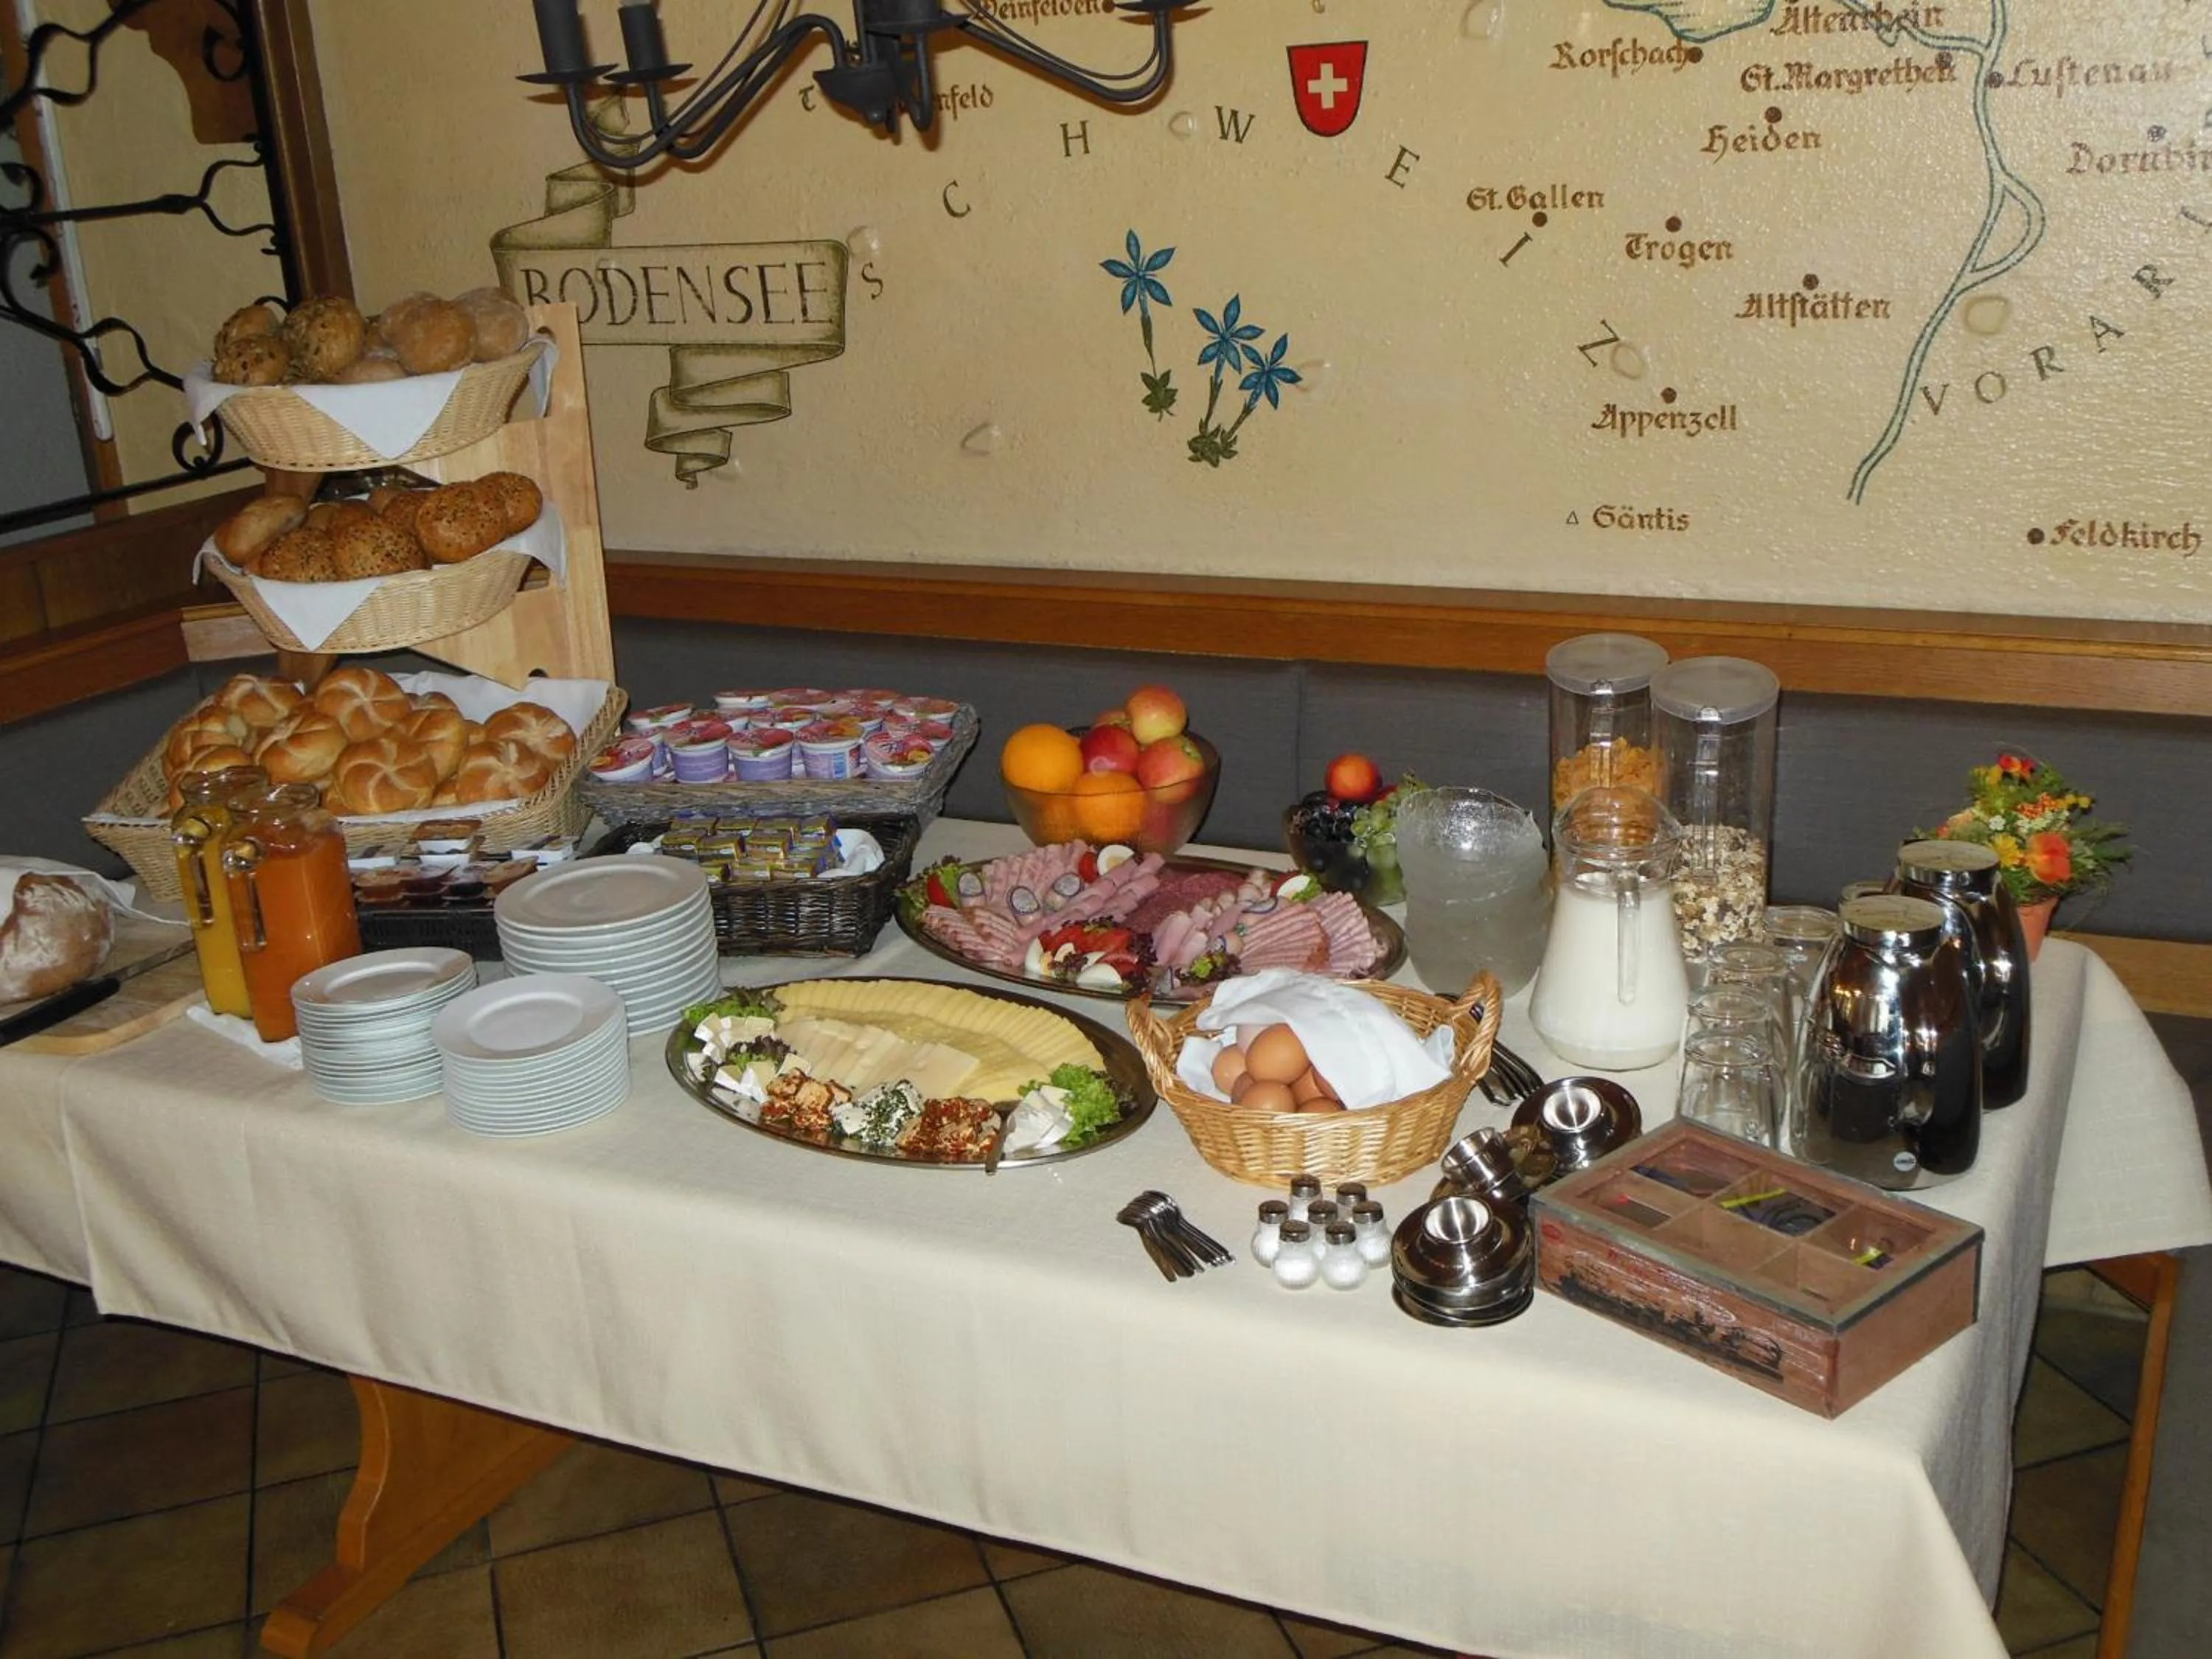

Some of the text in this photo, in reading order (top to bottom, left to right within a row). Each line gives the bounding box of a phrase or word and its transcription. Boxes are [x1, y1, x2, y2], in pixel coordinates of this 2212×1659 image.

[1700, 125, 1822, 164] Heiden
[1625, 232, 1733, 268] Trogen
[521, 261, 833, 326] BODENSEE
[1592, 404, 1737, 437] Appenzell
[2051, 520, 2201, 557] Feldkirch
